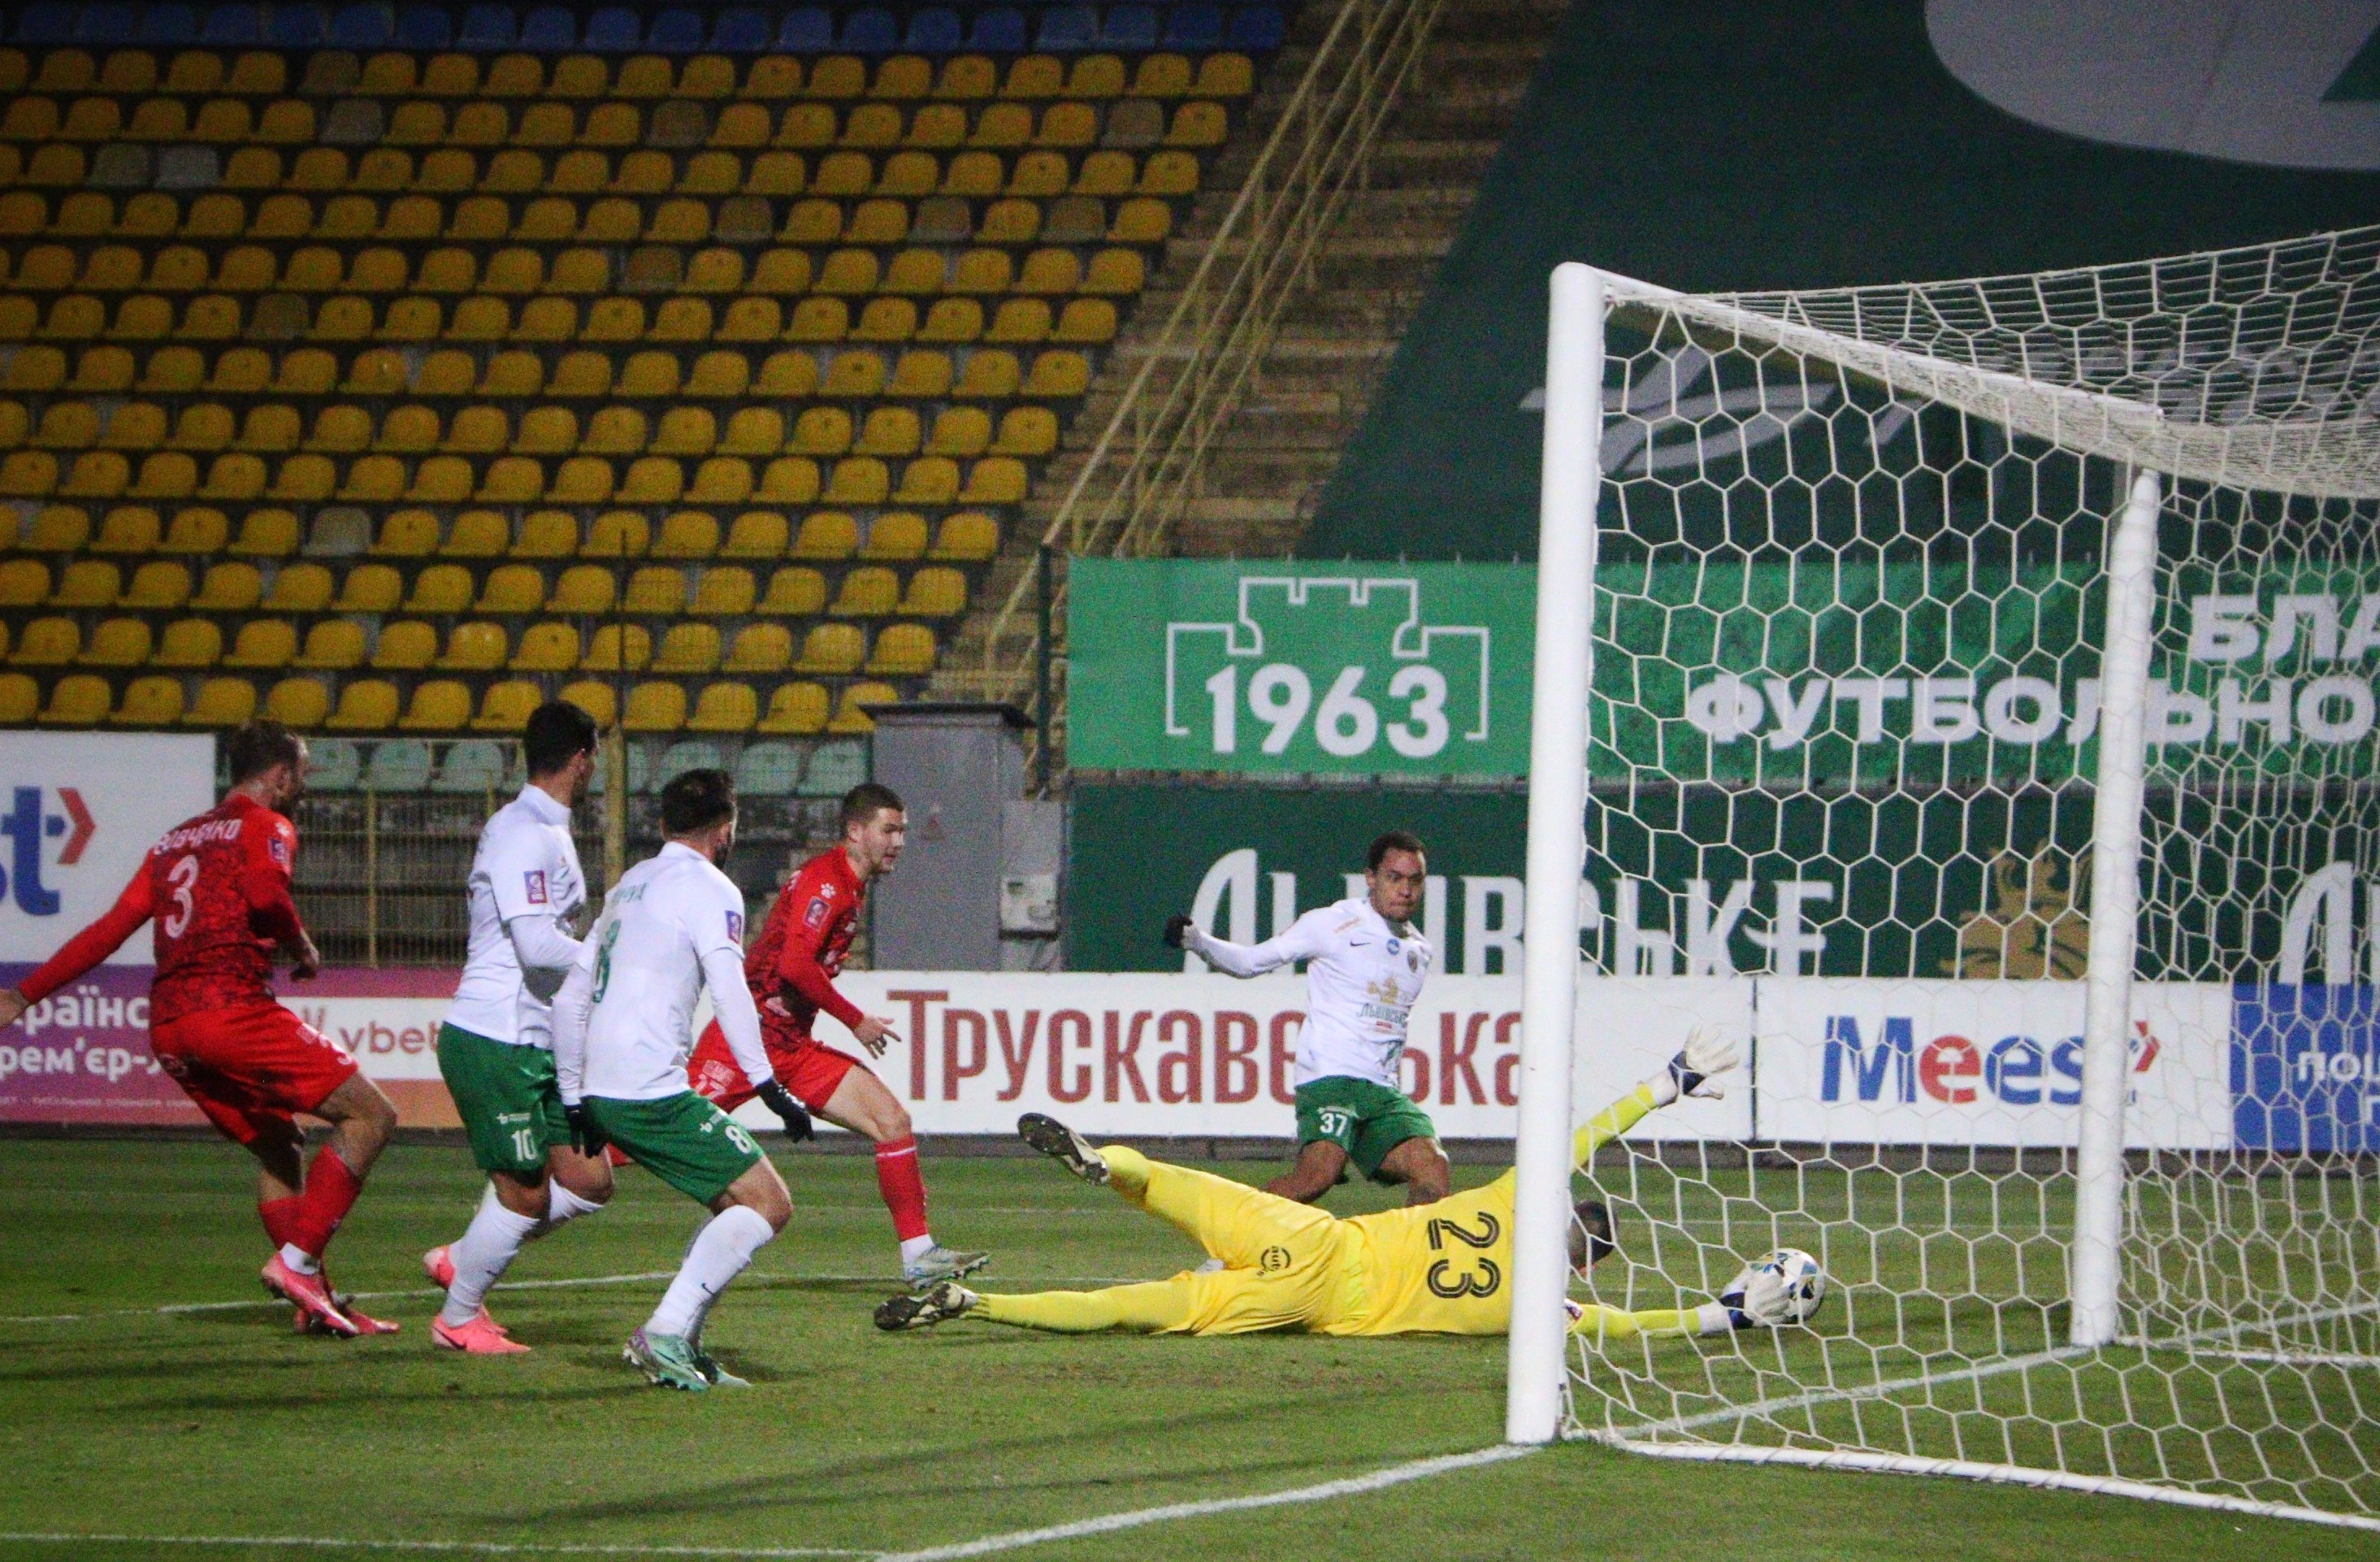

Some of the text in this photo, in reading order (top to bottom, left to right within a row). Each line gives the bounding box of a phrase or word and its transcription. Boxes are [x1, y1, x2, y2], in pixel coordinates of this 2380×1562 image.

[1206, 663, 1450, 758] 1963
[0, 786, 66, 916] t
[167, 854, 199, 939] 3
[0, 1036, 162, 1083] рем'єр-
[1821, 1016, 2139, 1105] Mees
[511, 1129, 538, 1161] 10
[725, 1125, 752, 1154] 8
[1319, 1113, 1348, 1137] 37
[1427, 1211, 1502, 1299] 23
